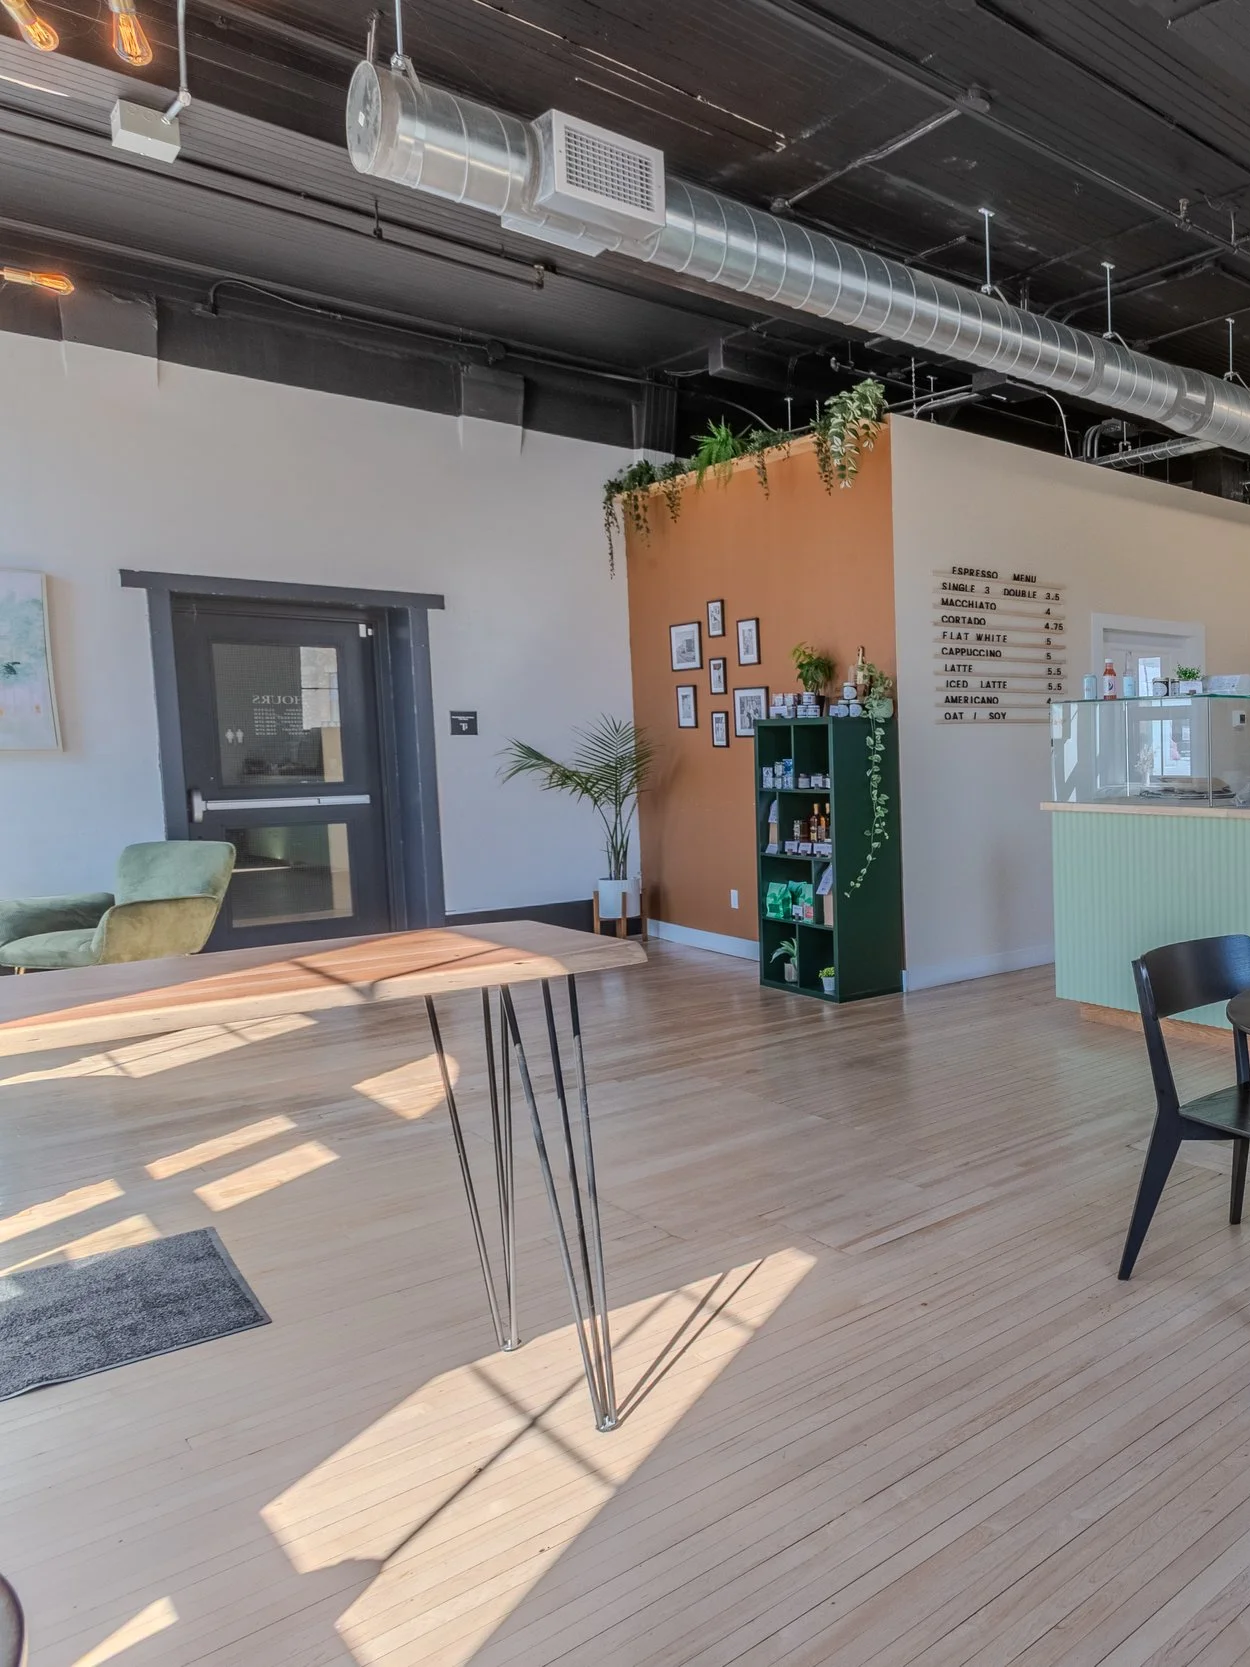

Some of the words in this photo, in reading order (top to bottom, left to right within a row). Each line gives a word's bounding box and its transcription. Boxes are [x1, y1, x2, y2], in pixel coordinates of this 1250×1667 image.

[952, 567, 999, 579] ESPRESSO
[1013, 574, 1037, 584] MENU
[942, 582, 976, 593] SINGLE
[983, 587, 991, 595] 3
[1003, 588, 1037, 598] DOUBLE
[1045, 593, 1059, 601] 3.5
[941, 598, 997, 610] MACCHIATO
[1044, 608, 1051, 616] 4
[941, 615, 987, 625] CORTADO
[1045, 623, 1063, 631] 4.75
[943, 632, 970, 641] FLAT
[976, 634, 1008, 644] WHITE
[1046, 638, 1052, 646] 5
[942, 647, 1002, 657] CAPPUCCINO
[945, 664, 973, 673] LATTE
[1048, 668, 1061, 676] 5.5
[946, 680, 969, 689] ICED
[981, 681, 1008, 690] LATTE
[1048, 683, 1062, 691] 5.5
[944, 696, 1000, 705] AMERICANO
[945, 712, 964, 721] OAT
[989, 712, 1007, 720] SOY
